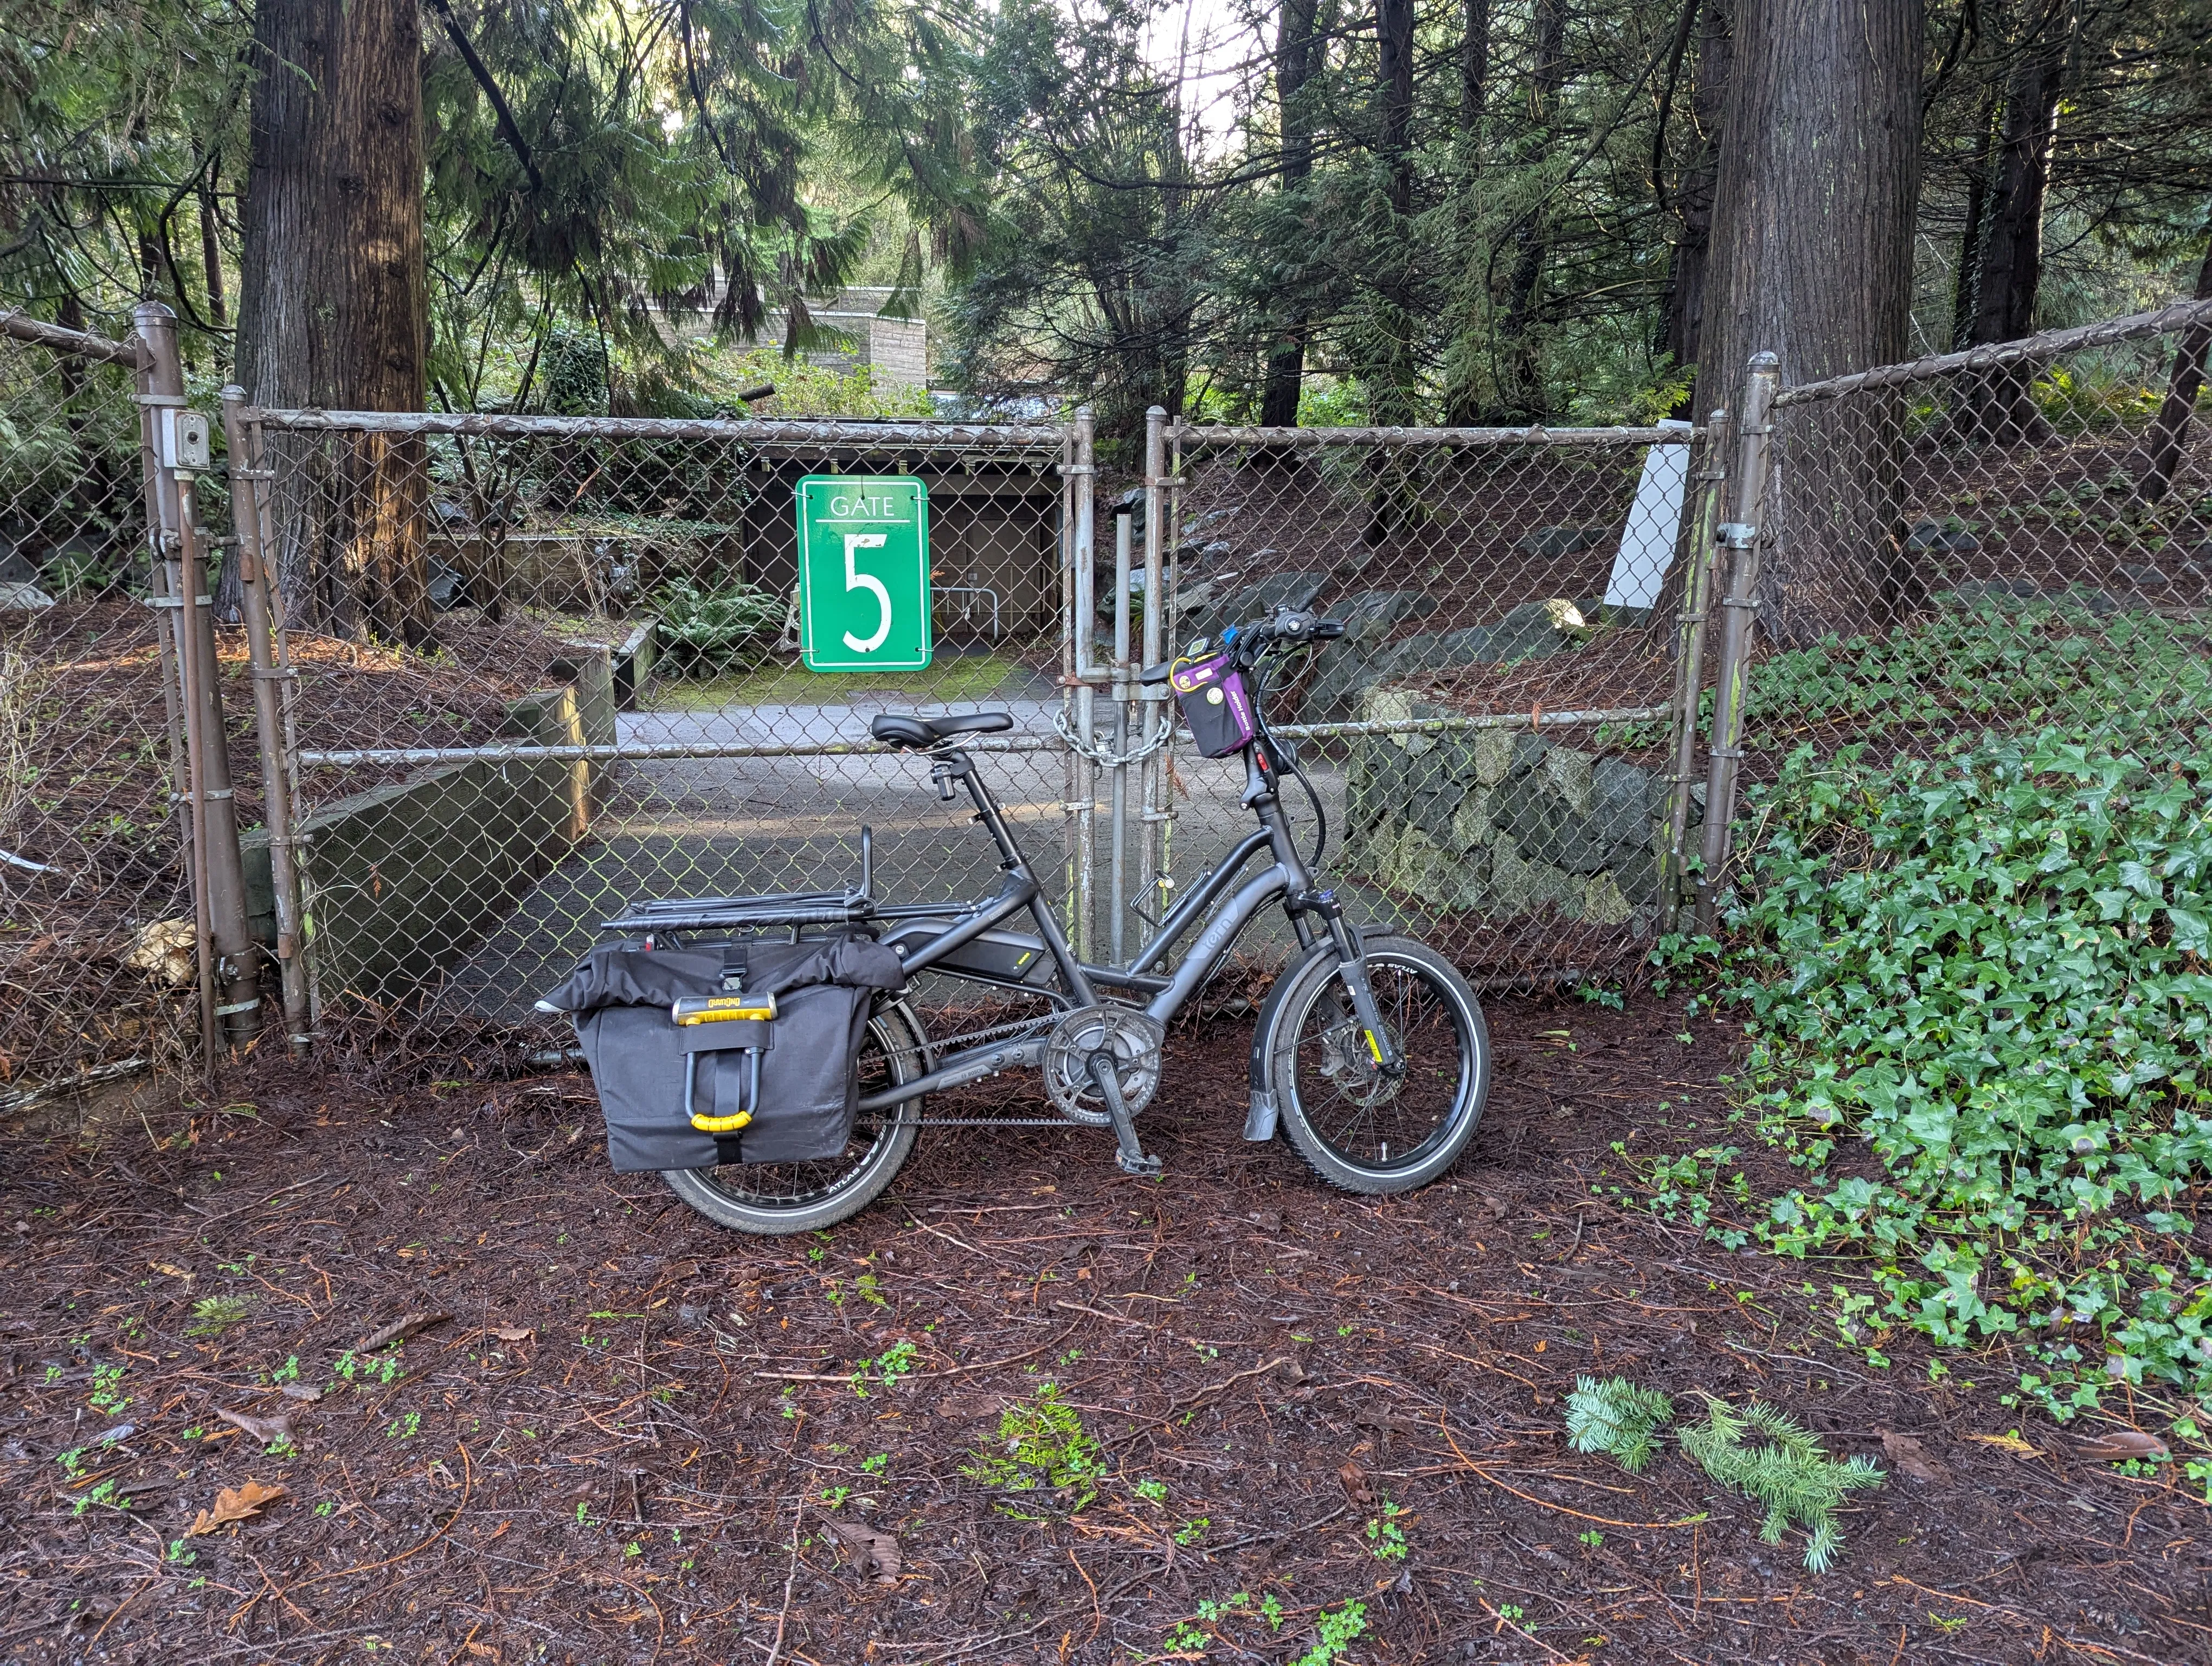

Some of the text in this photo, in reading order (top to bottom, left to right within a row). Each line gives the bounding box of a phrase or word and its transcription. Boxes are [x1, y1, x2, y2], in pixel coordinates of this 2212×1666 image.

[831, 496, 895, 517] GATE
[843, 534, 892, 653] 5
[1230, 691, 1244, 712] Holder
[1387, 963, 1418, 974] ATLAS
[968, 1067, 983, 1077] BOSCH
[828, 1167, 860, 1194] ATLAS
